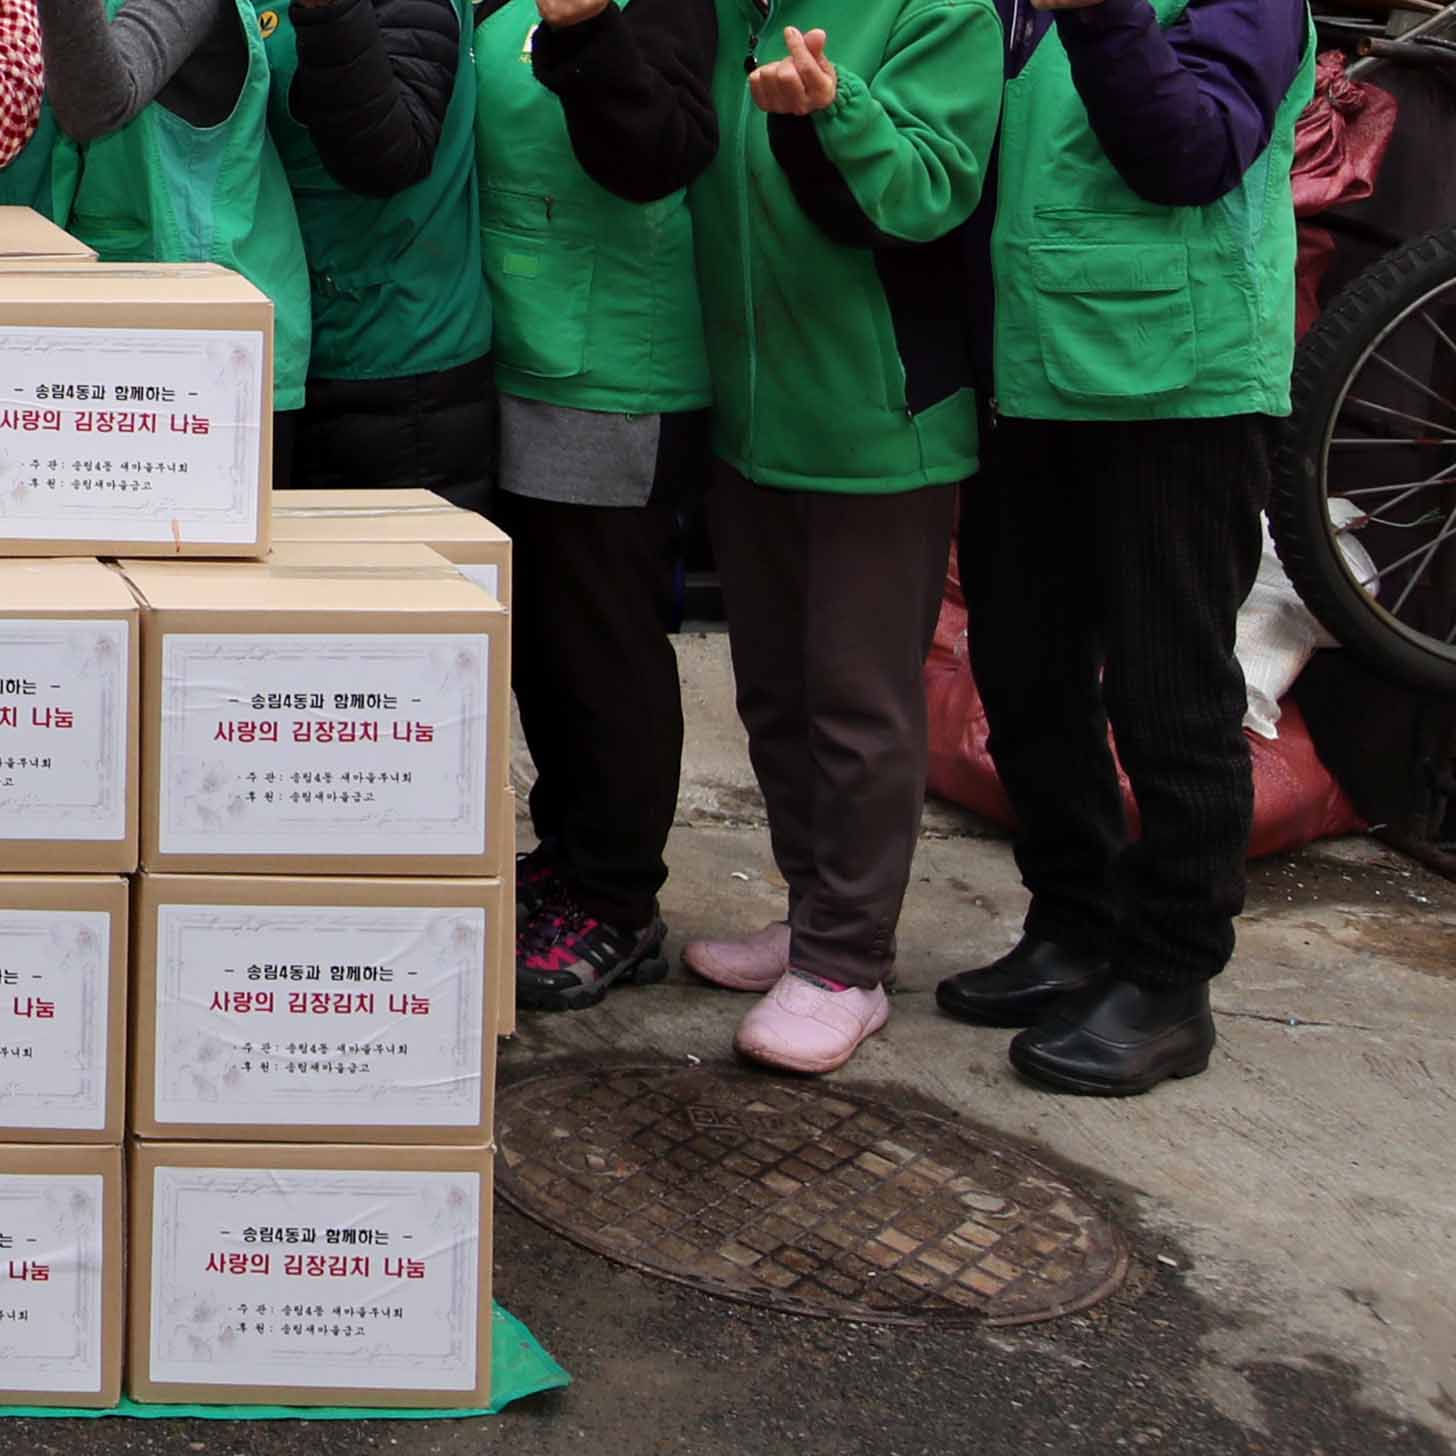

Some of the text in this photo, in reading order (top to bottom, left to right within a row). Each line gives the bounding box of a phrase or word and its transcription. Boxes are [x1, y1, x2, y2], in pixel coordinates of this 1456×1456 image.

[0, 410, 209, 434] 사랑의 김장김치 나눔
[252, 693, 397, 709] 송림4동과 함께하는
[32, 707, 73, 728] 나눔
[215, 721, 433, 743] 사랑의 김장김치 나눔
[14, 997, 54, 1018] 나눔
[212, 992, 429, 1015] 사랑의 김장김치 나눔
[9, 1261, 49, 1281] 나눔
[206, 1253, 424, 1279] 사랑의 김장김치 나눔
